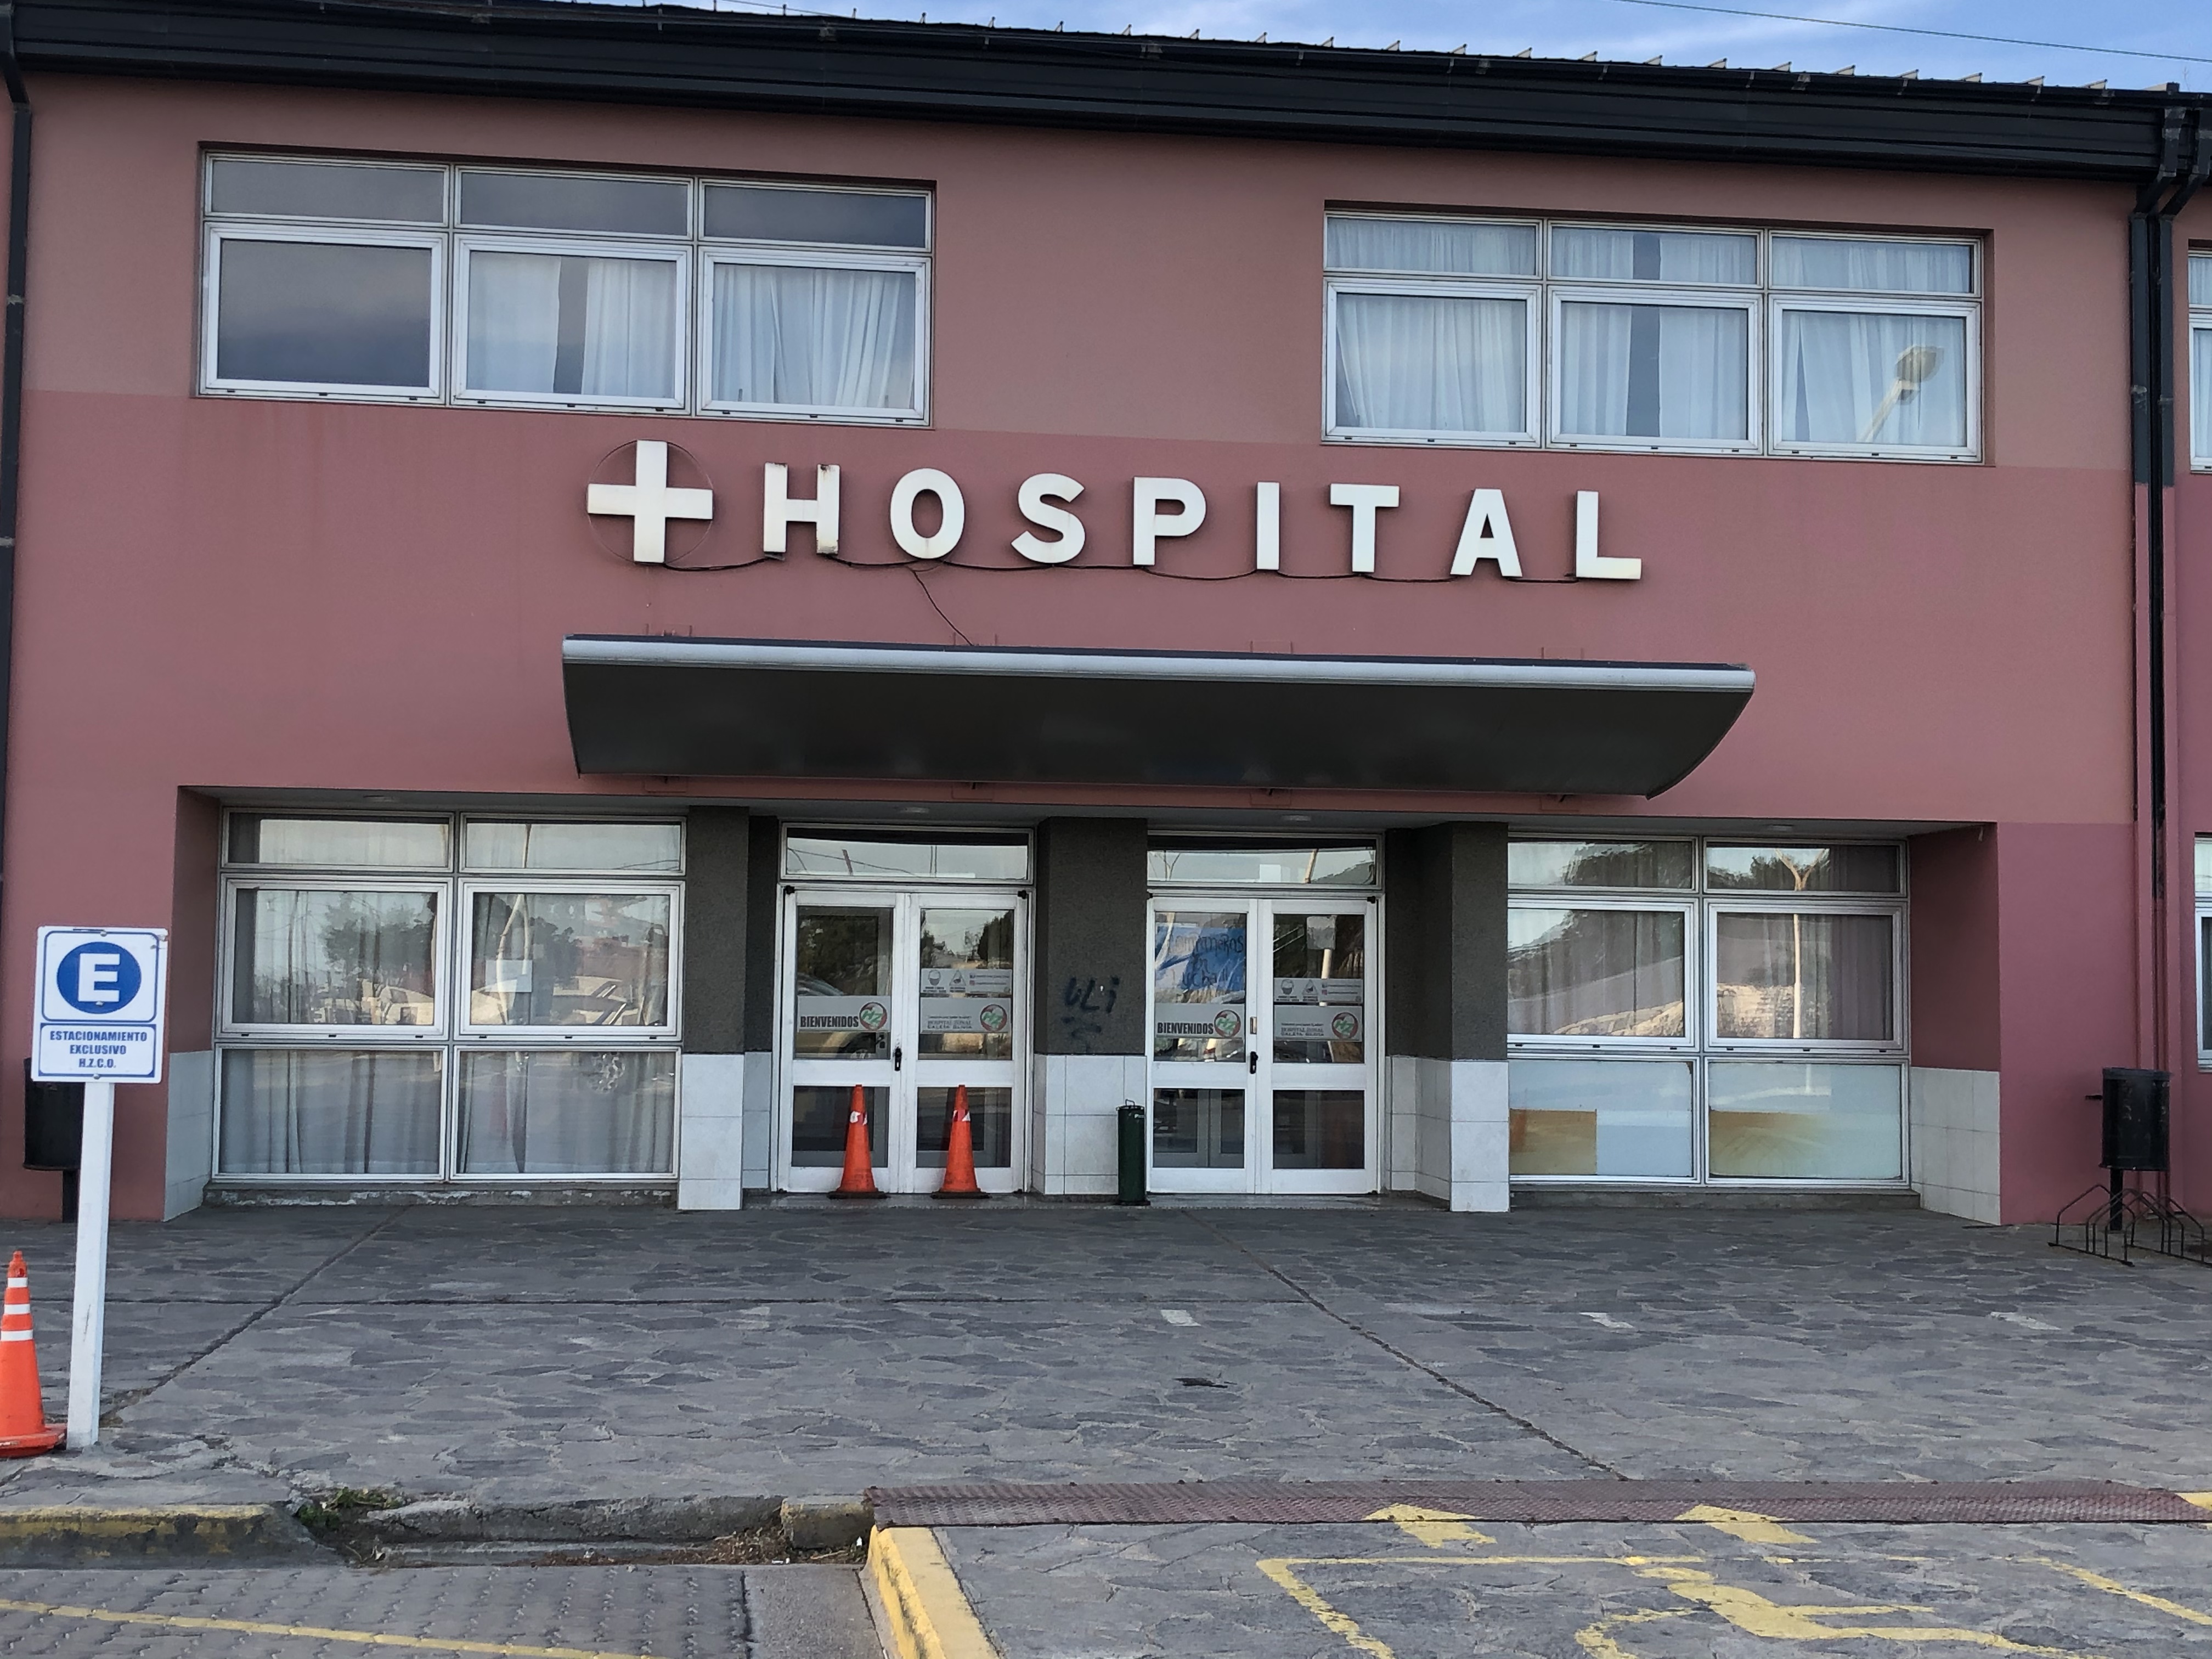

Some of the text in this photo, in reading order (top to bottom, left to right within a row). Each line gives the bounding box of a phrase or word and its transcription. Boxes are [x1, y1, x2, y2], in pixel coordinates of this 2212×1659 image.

[763, 462, 1641, 580] HOSPITAL
[77, 953, 120, 1002] E
[800, 1016, 859, 1028] BIENVENIDOS
[1157, 1022, 1214, 1034] BIENVENIDOS
[50, 1031, 147, 1041] ESTACIONAMIENTO
[70, 1045, 127, 1054] EXCLUSIVO
[78, 1058, 116, 1068] H.Z.C.O.
